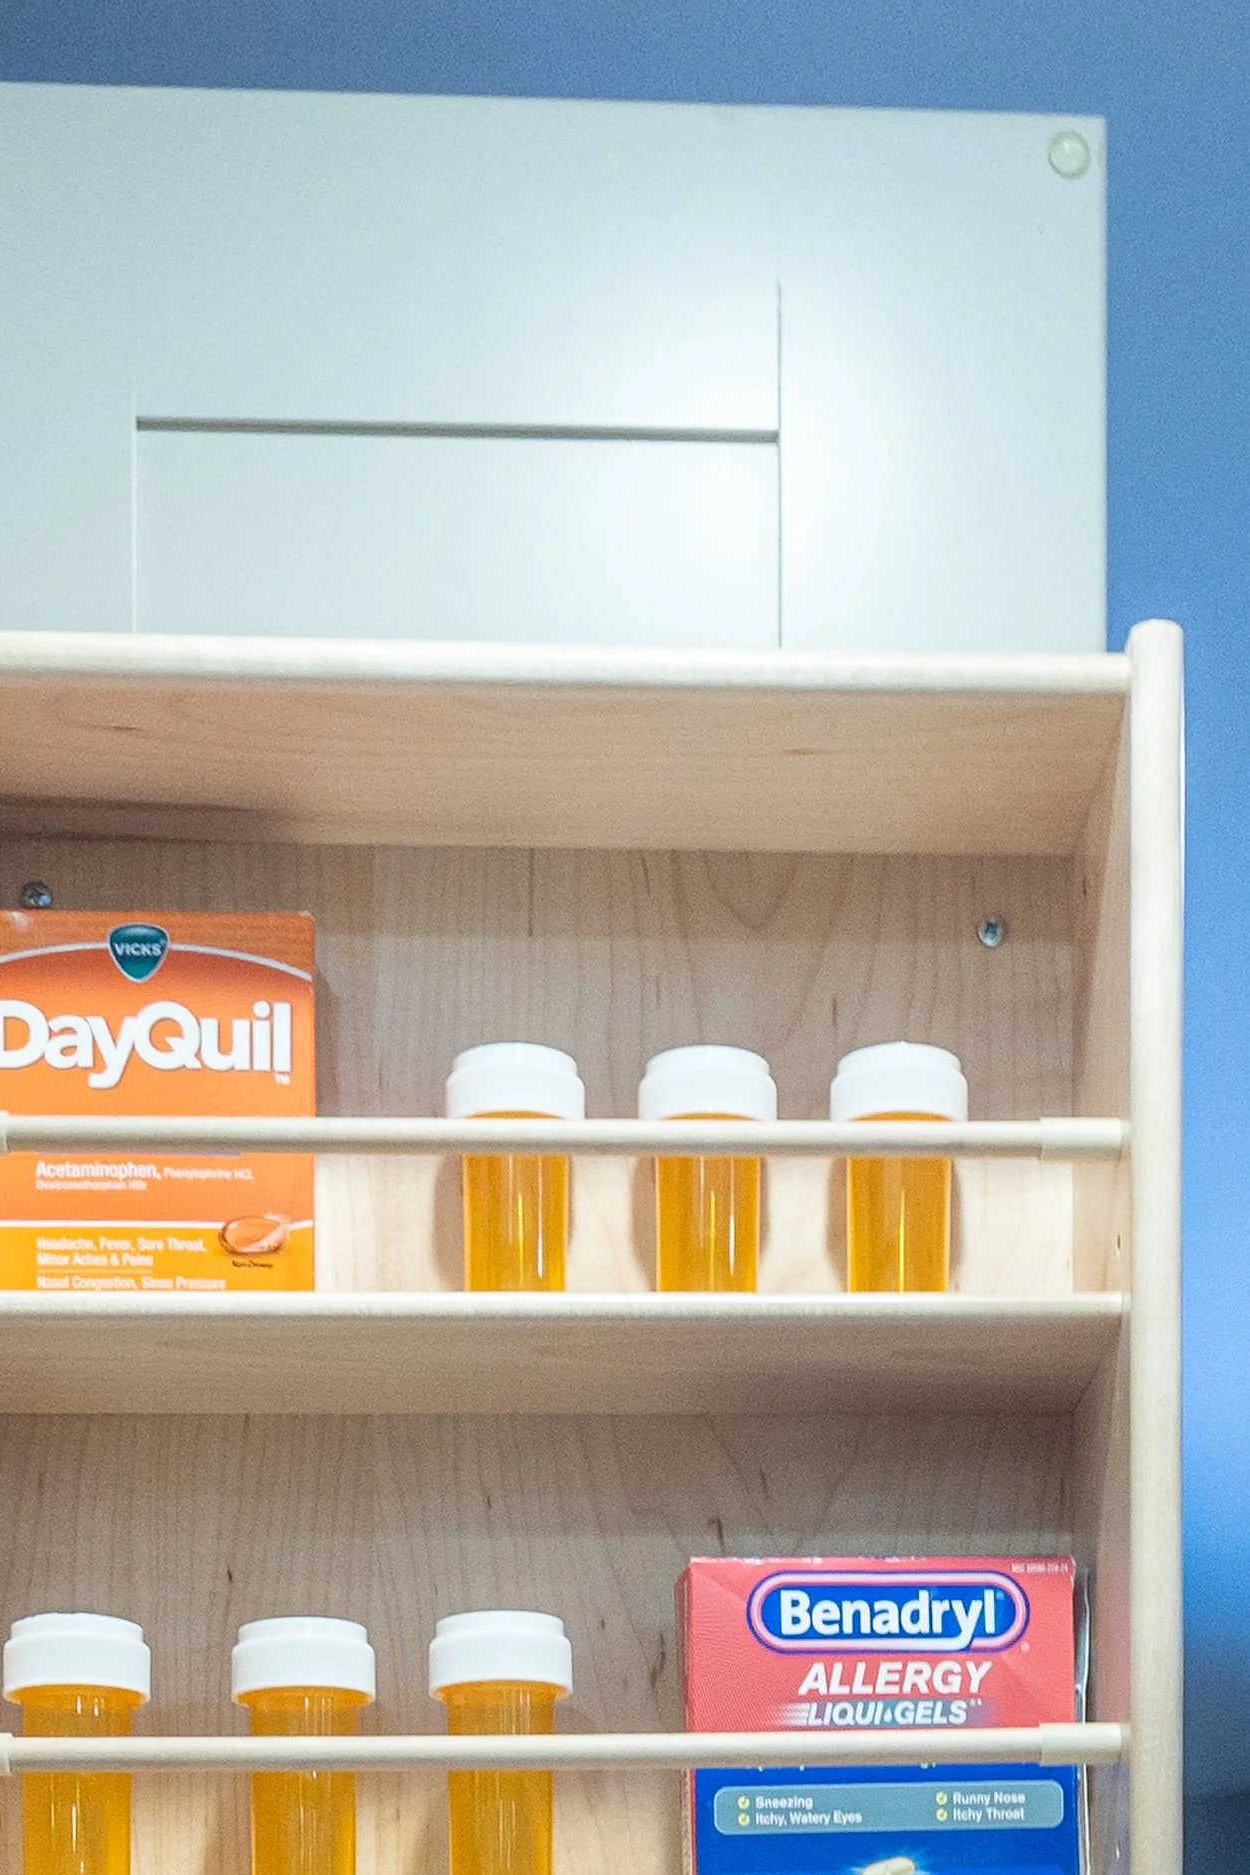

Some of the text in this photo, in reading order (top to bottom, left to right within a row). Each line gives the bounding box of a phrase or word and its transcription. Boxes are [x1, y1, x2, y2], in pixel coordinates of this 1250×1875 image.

[113, 942, 162, 957] VICKS
[36, 1161, 162, 1181] Acetaminophen,
[779, 1589, 996, 1644] Benadryl
[798, 1661, 993, 1696] ALLERGY
[755, 1795, 813, 1810] Sneezing
[953, 1791, 1026, 1807] Runny Nose
[755, 1810, 863, 1827] Itchy, Watery Eyes
[953, 1807, 1025, 1823] Itchy Throat
